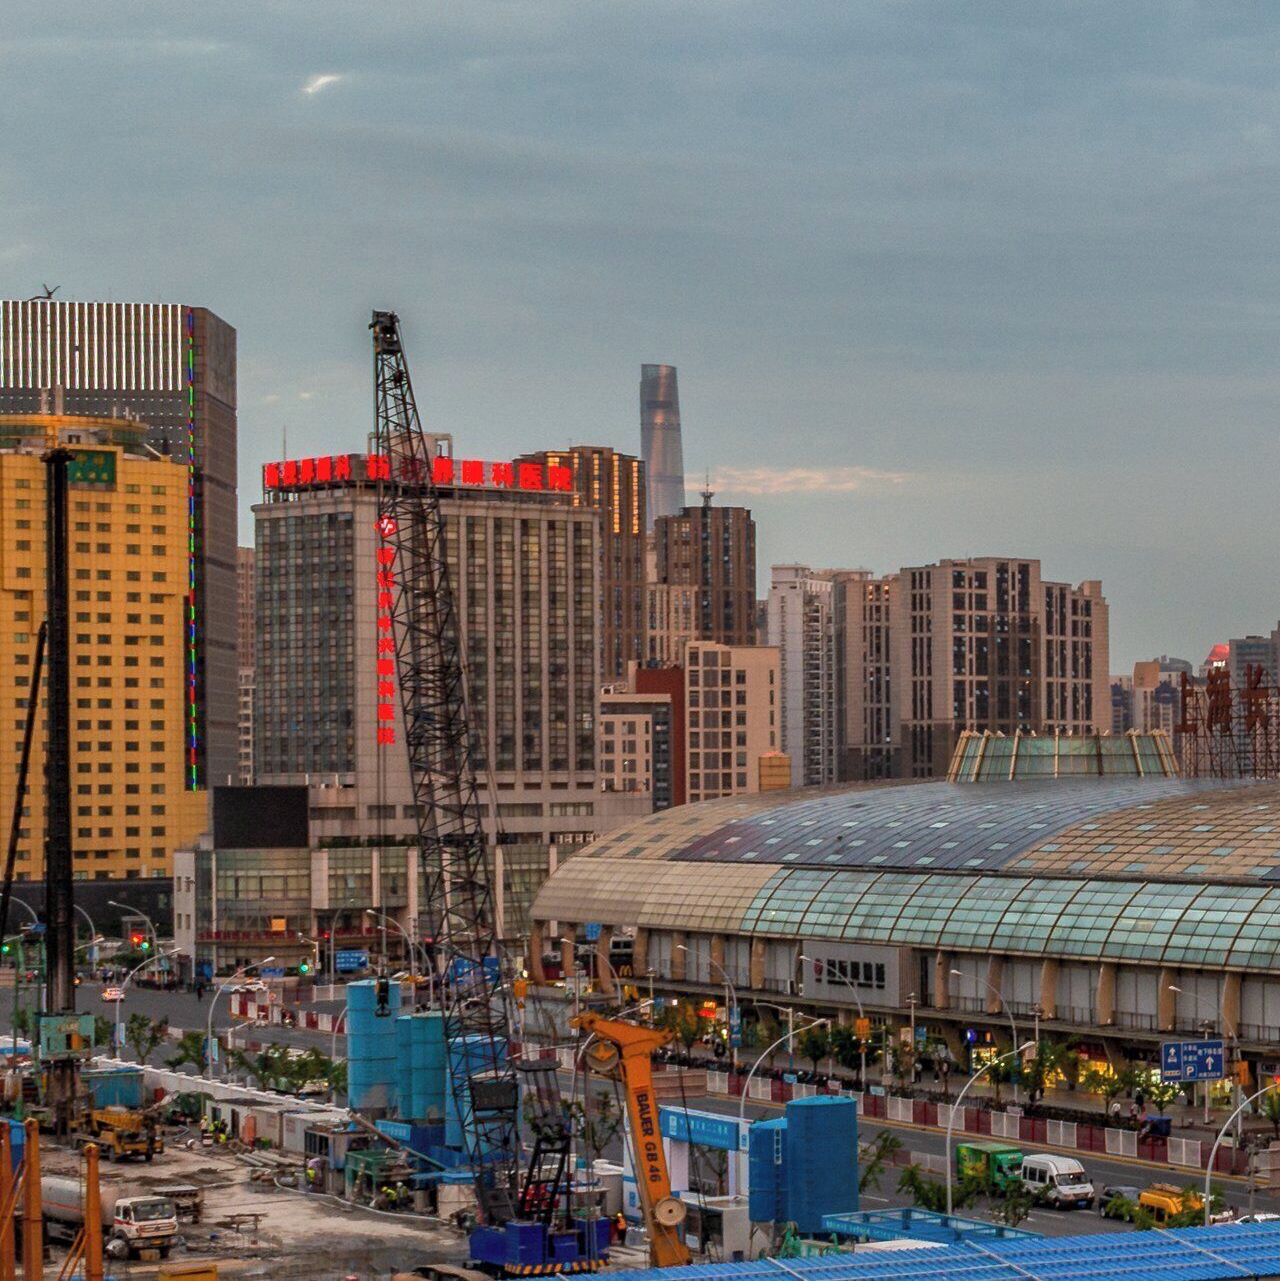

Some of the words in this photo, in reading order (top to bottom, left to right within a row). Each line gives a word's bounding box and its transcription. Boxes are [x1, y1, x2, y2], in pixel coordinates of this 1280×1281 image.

[1186, 1066, 1195, 1076] P
[636, 1093, 655, 1137] BAUER
[645, 1142, 659, 1163] GB
[649, 1164, 661, 1183] 46
